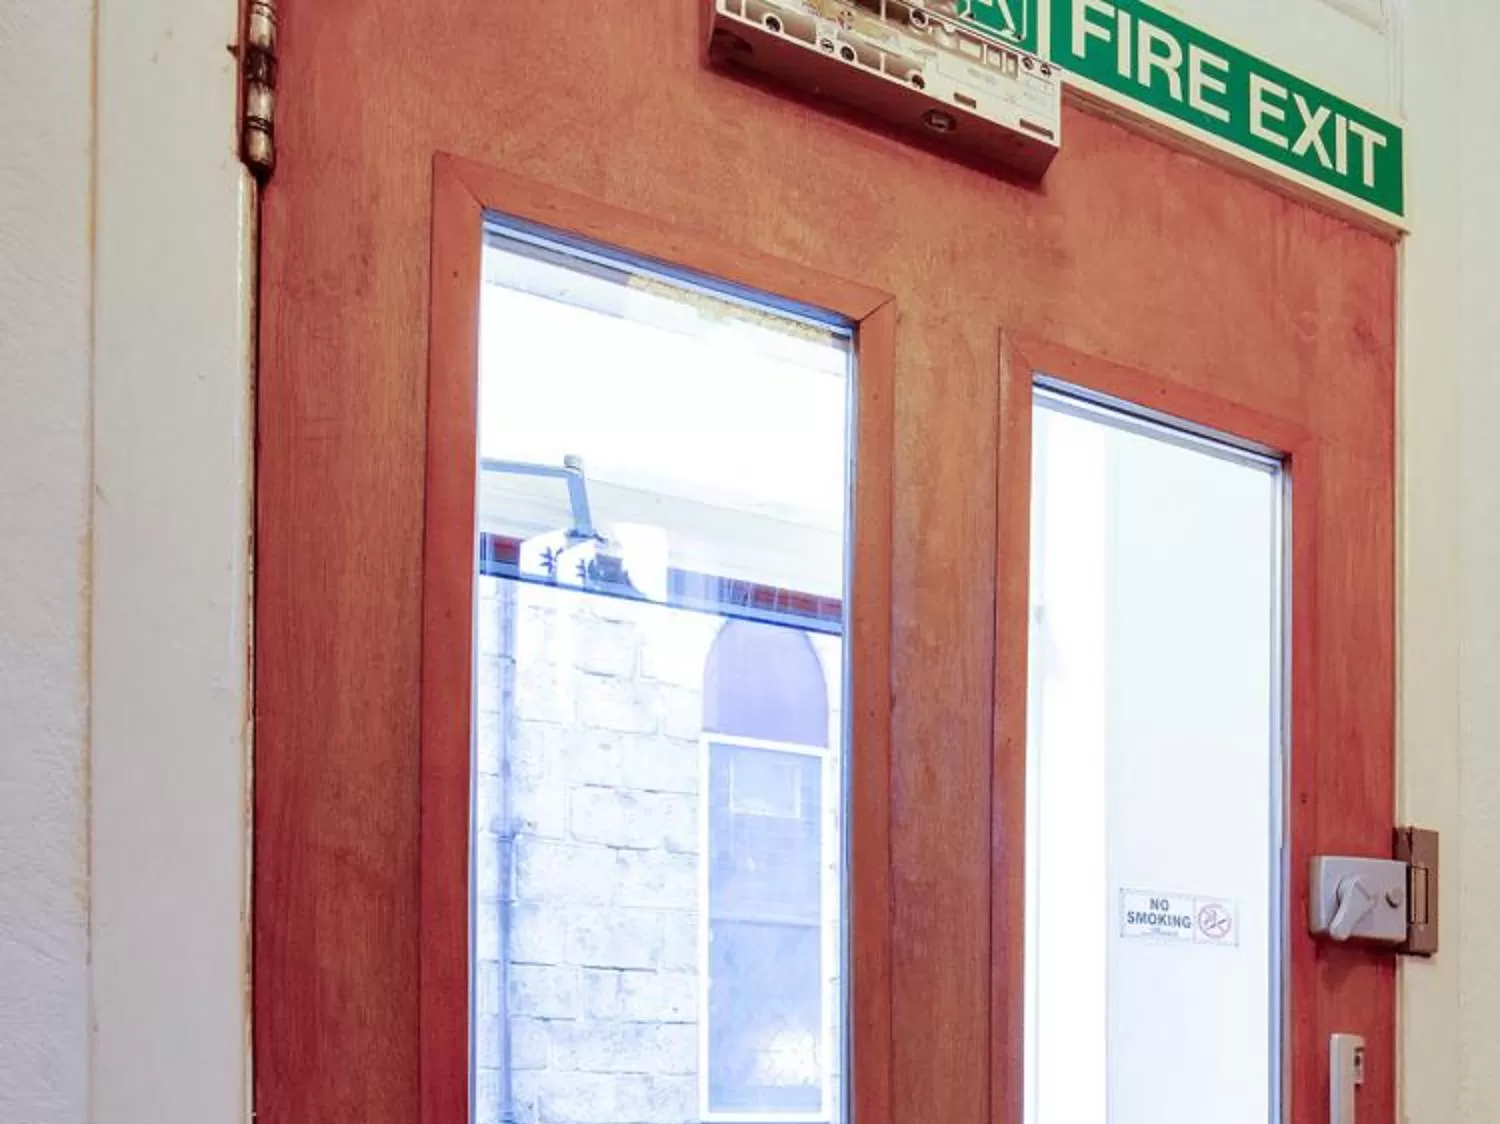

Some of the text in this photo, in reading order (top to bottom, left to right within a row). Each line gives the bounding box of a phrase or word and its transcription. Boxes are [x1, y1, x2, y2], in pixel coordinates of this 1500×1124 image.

[1071, 0, 1388, 189] FIRE EXIT
[1149, 898, 1170, 912] NO
[1127, 911, 1192, 929] SMOKING
